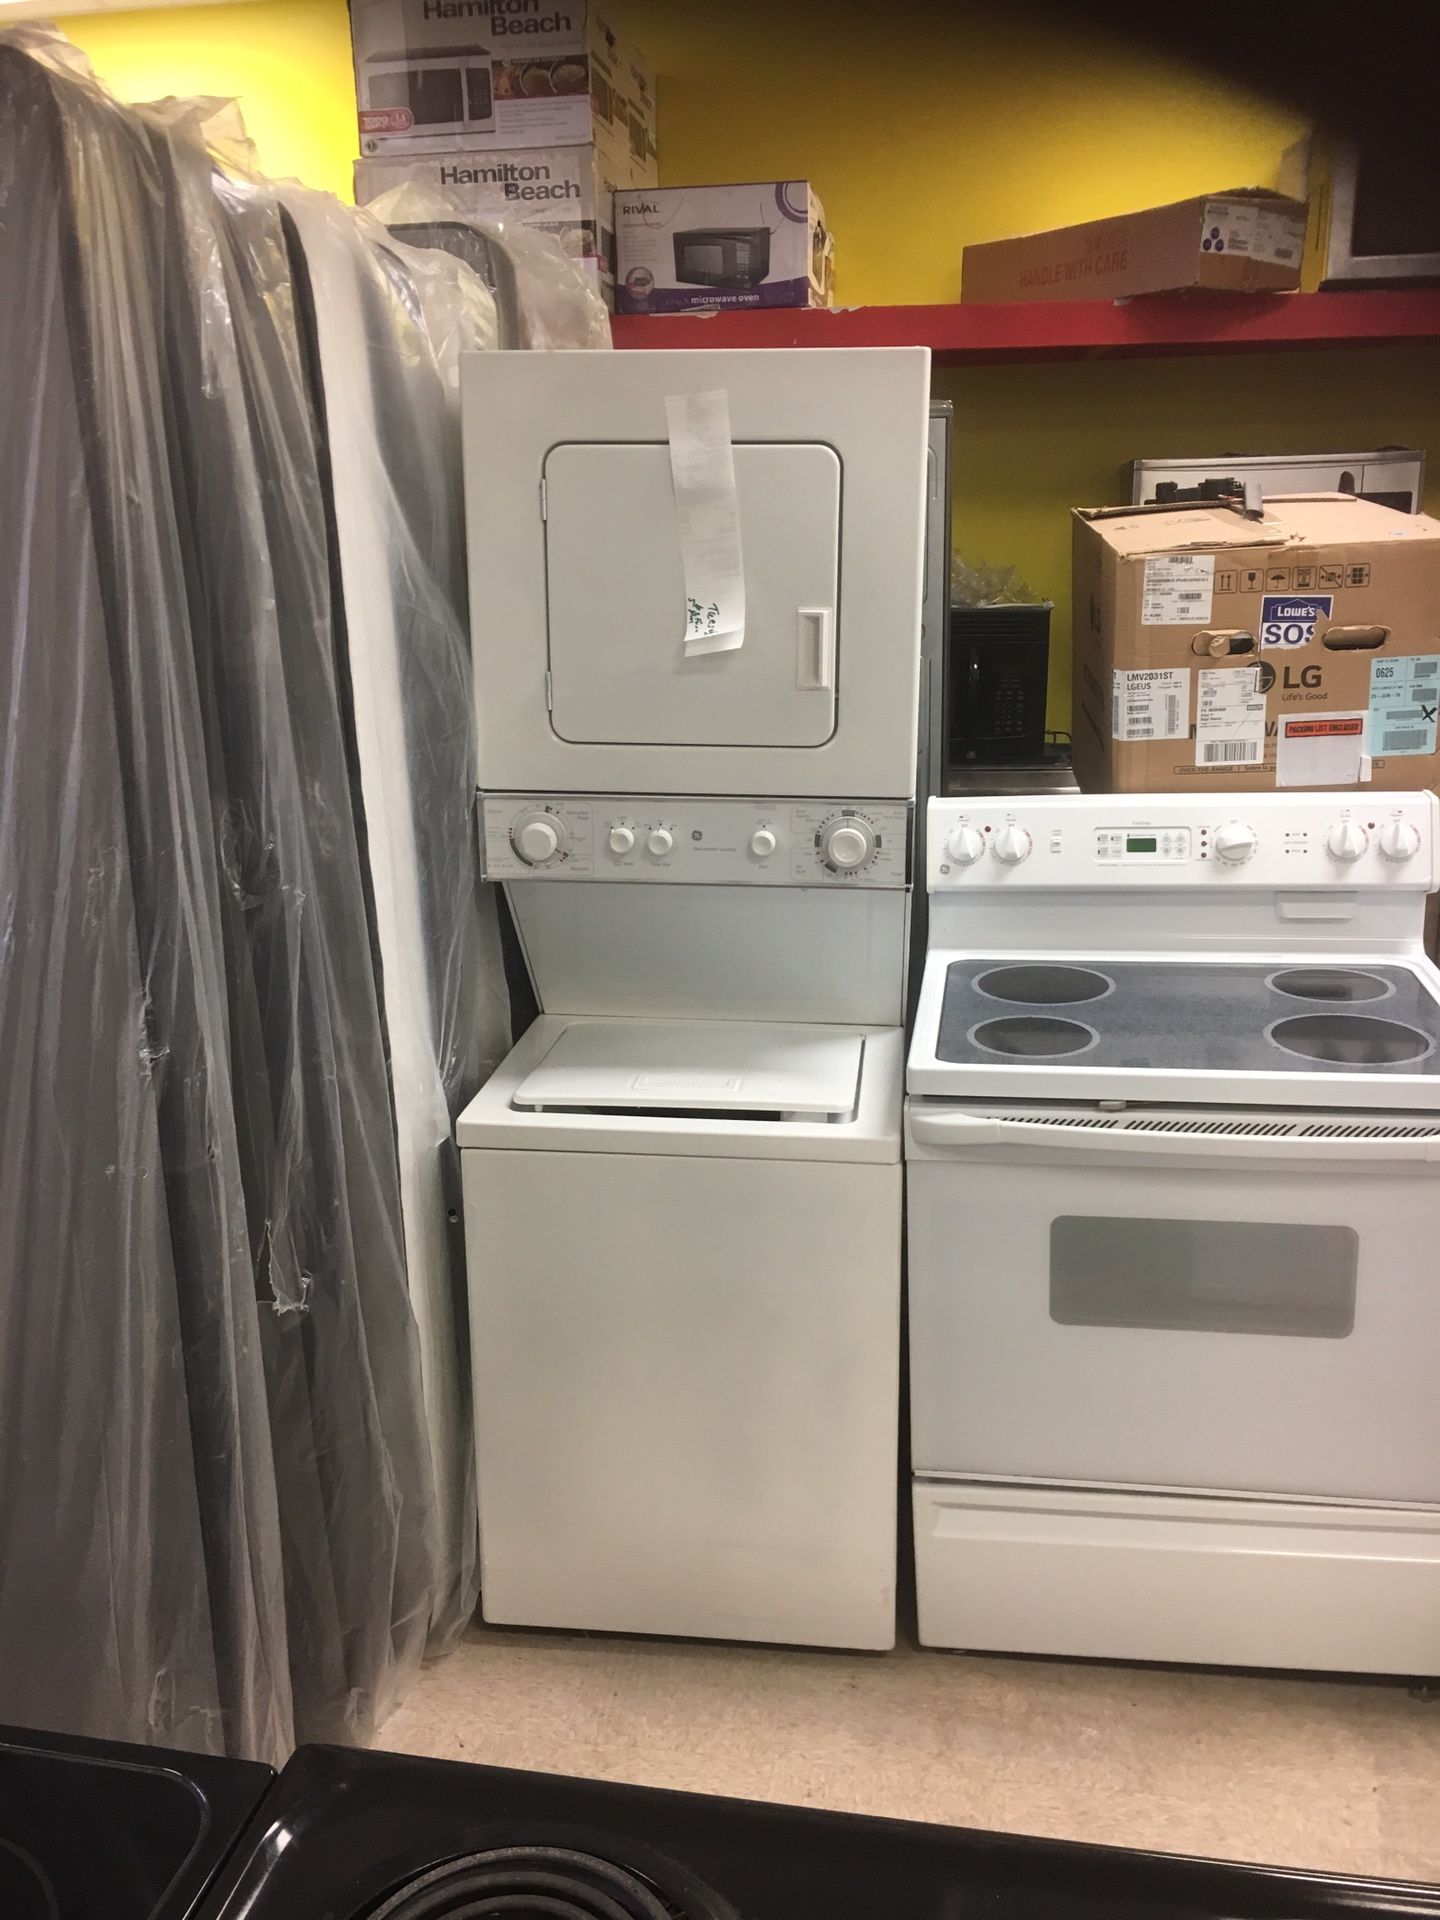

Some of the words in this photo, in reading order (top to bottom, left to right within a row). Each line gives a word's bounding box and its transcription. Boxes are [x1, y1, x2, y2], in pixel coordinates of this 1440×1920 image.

[424, 0, 540, 20] Hamilton
[491, 11, 572, 36] Beach
[440, 163, 550, 185] Hamilton
[504, 179, 581, 201] Beach
[623, 202, 660, 215] RIVAL
[1019, 263, 1062, 288] HANDLE
[1064, 258, 1092, 280] WITH
[1094, 251, 1129, 276] CARE
[690, 295, 738, 304] microwave
[738, 293, 760, 302] oven
[1277, 606, 1315, 617] LOWE'S
[1126, 672, 1174, 682] LMV2031ST
[1282, 665, 1322, 689] LG
[1375, 667, 1394, 678] 0625
[1126, 682, 1151, 691] LGEUS
[1282, 693, 1303, 701] Life's
[1305, 692, 1328, 701] Good
[1315, 724, 1328, 732] LIST
